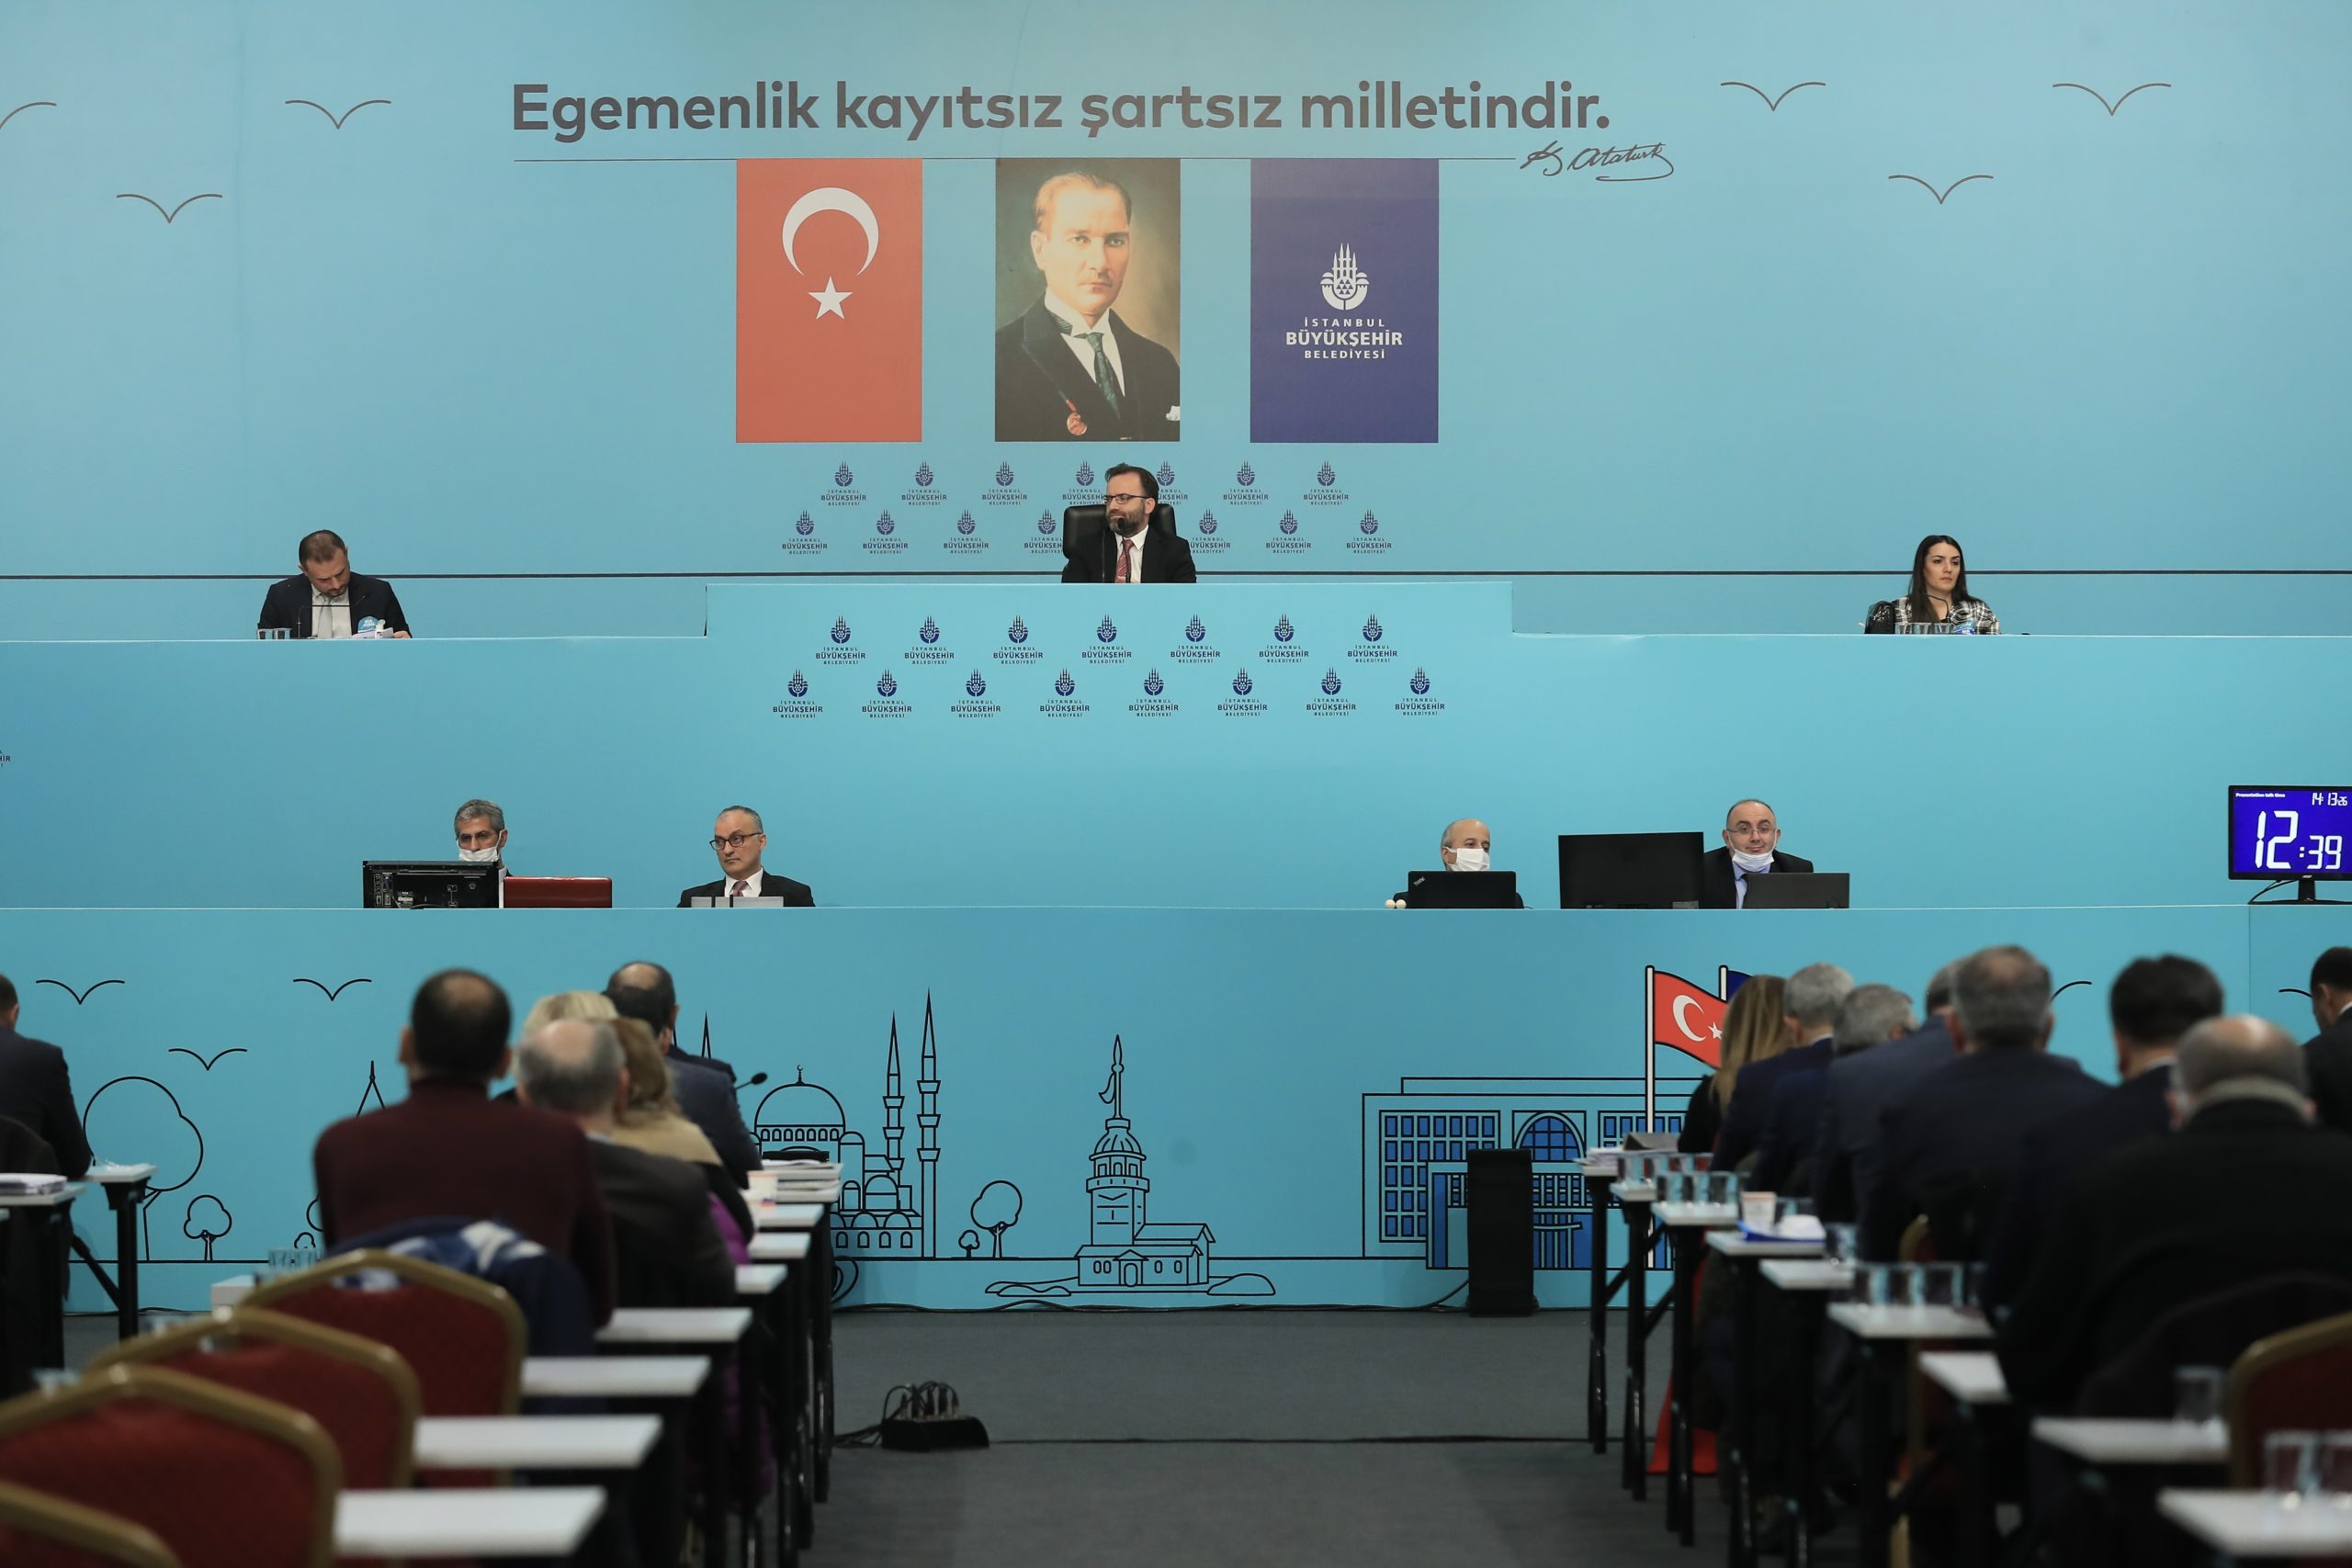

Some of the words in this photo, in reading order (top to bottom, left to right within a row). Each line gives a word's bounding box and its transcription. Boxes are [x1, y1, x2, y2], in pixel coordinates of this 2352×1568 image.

[514, 81, 820, 143] Egemenlik
[837, 81, 1061, 141] kayıtsız
[1081, 86, 1281, 138] şartsız
[1302, 81, 1611, 130] milletindir.
[1304, 317, 1386, 327] İSTANBUL
[1285, 330, 1403, 347] BÜYÜKŞEHİR
[1304, 349, 1385, 359] BELEDİYESİ
[993, 651, 1044, 660] BÜYÜKŞEHİR
[1128, 704, 1179, 712] BÜYÜKŞEHİR
[1395, 703, 1445, 711] BÜYÜKŞEHİR
